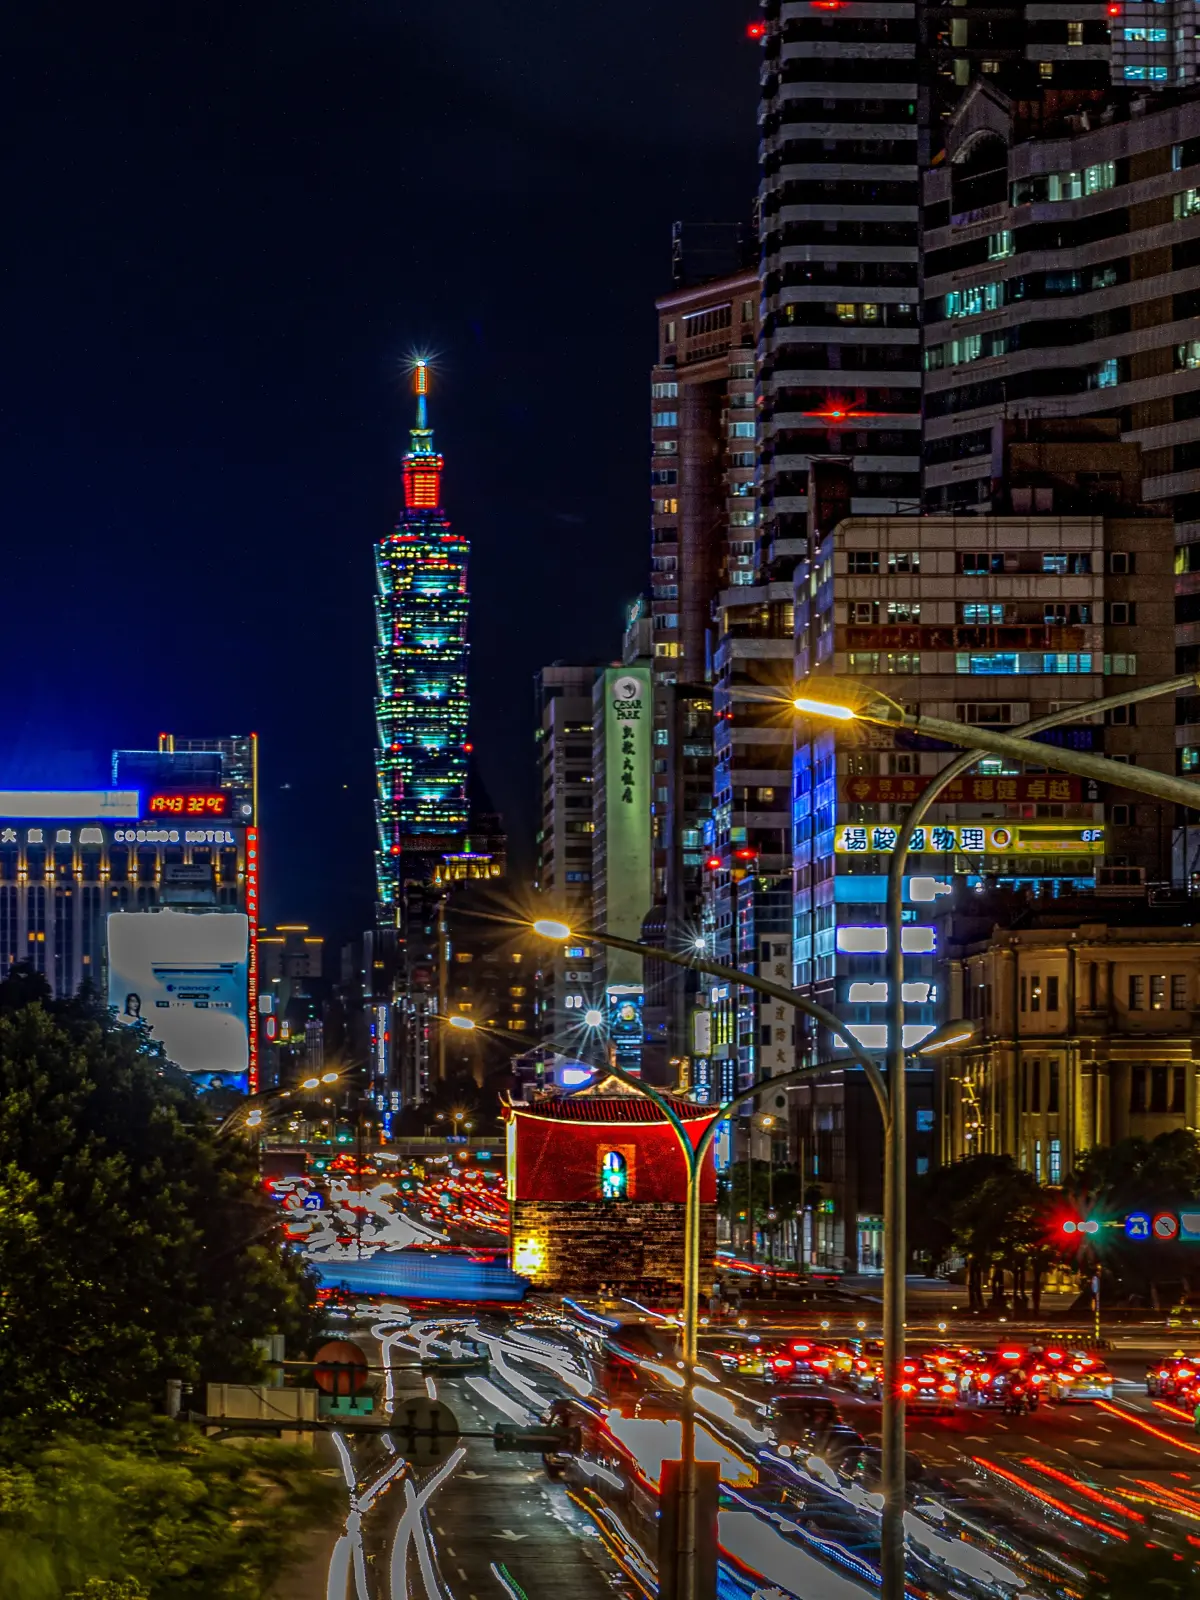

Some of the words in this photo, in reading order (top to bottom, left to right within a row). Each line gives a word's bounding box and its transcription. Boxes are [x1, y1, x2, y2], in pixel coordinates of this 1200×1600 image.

[613, 700, 643, 710] CESAR
[617, 710, 641, 720] PARK
[1027, 779, 1071, 800] 卓越
[114, 830, 180, 843] COSMOS
[185, 830, 235, 843] HOTEL
